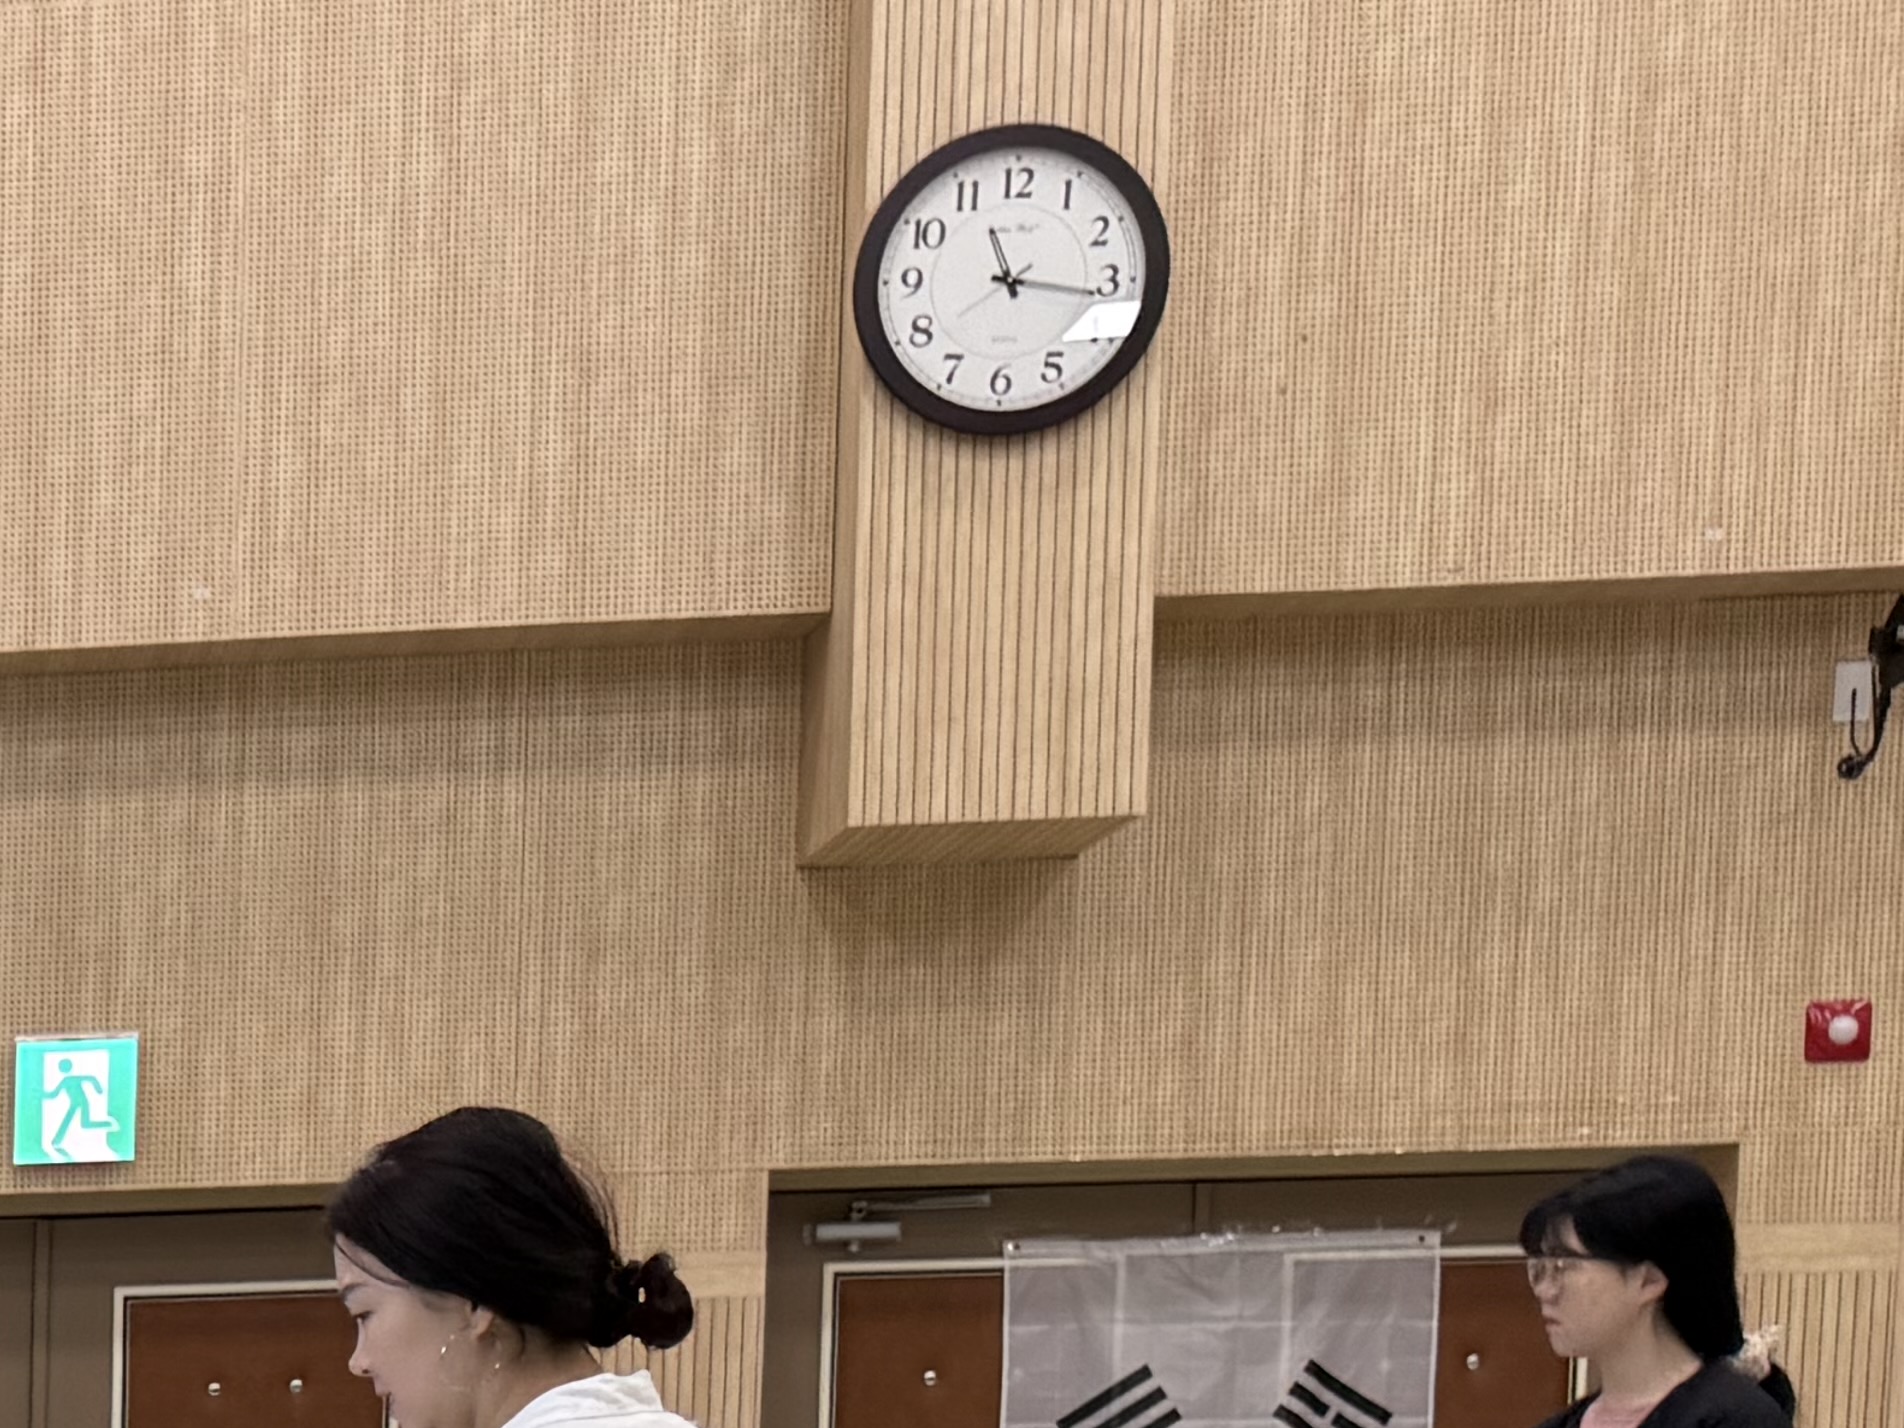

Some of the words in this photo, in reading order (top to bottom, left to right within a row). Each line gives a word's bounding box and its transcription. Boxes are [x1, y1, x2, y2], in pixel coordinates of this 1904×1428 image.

[956, 180, 979, 212] 11
[1003, 167, 1035, 199] 12
[1062, 179, 1072, 210] 1
[912, 217, 946, 249] 10
[1088, 215, 1110, 247] 2
[900, 266, 924, 298] 9
[1095, 263, 1120, 297] 3
[908, 314, 933, 348] 8
[943, 352, 964, 385] 7
[989, 362, 1012, 396] 6
[1040, 351, 1065, 383] 5
